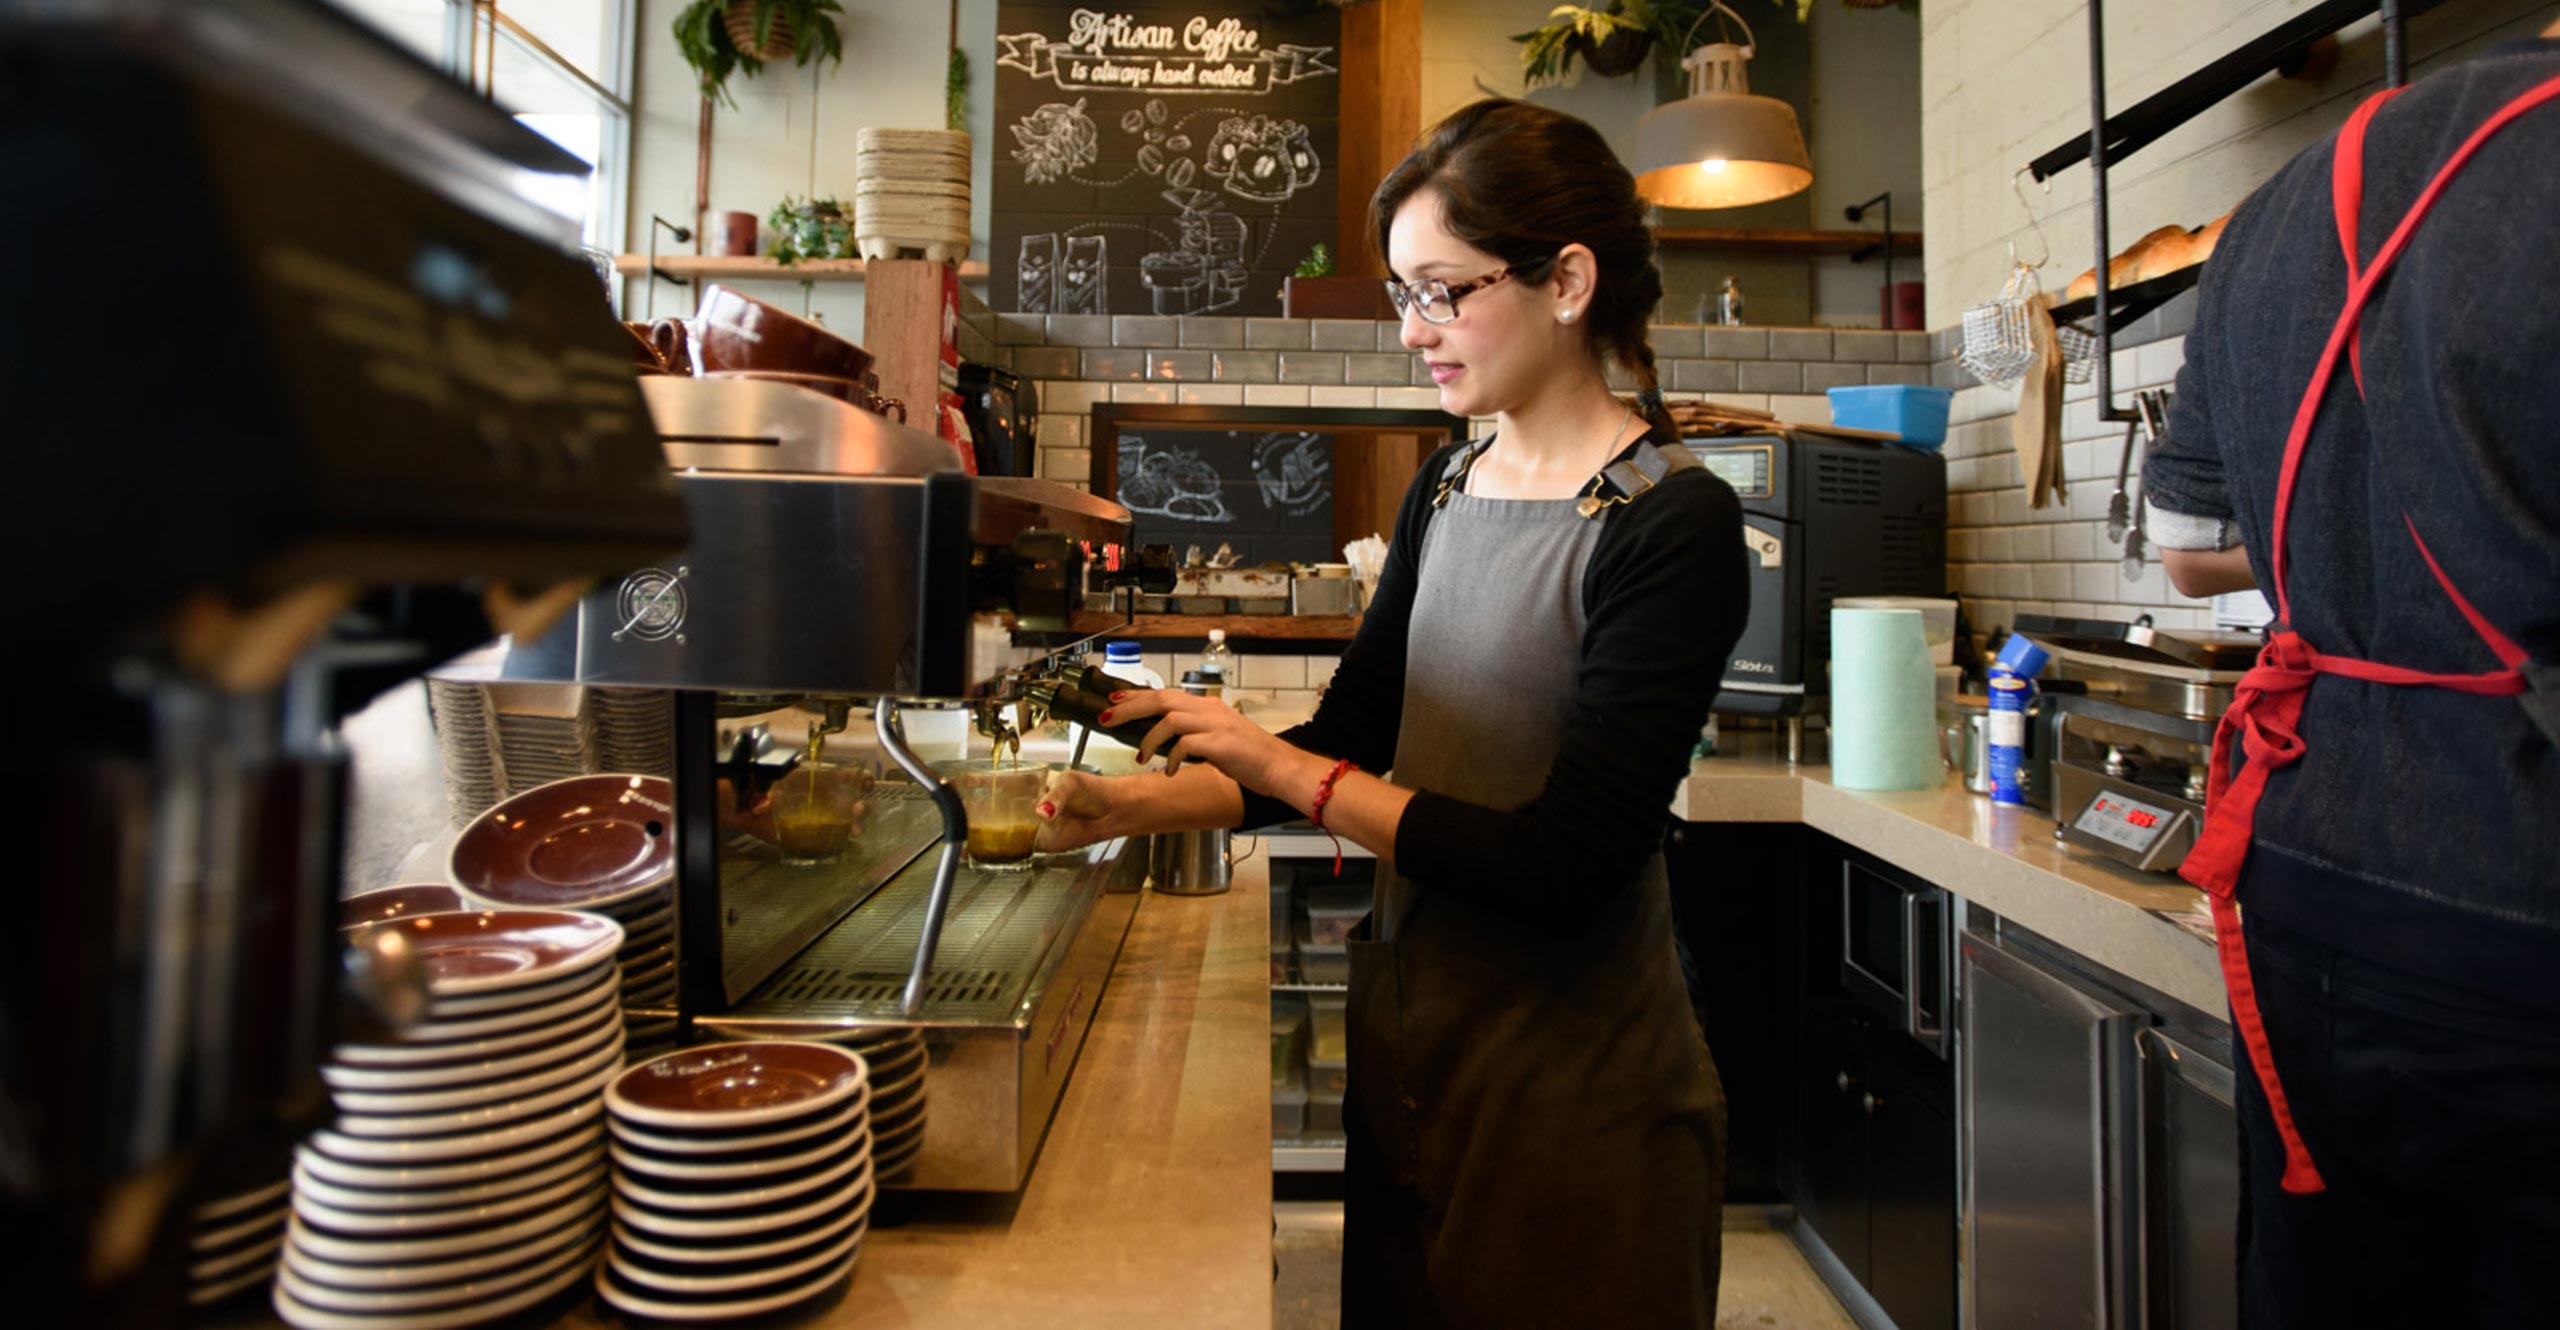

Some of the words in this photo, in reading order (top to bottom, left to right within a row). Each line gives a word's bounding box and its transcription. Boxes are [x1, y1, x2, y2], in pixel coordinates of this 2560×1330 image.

[1068, 8, 1177, 59] Artisan
[1183, 16, 1260, 62] Coffee
[1070, 60, 1088, 81] is
[1091, 59, 1150, 88] always
[1152, 60, 1195, 84] hand
